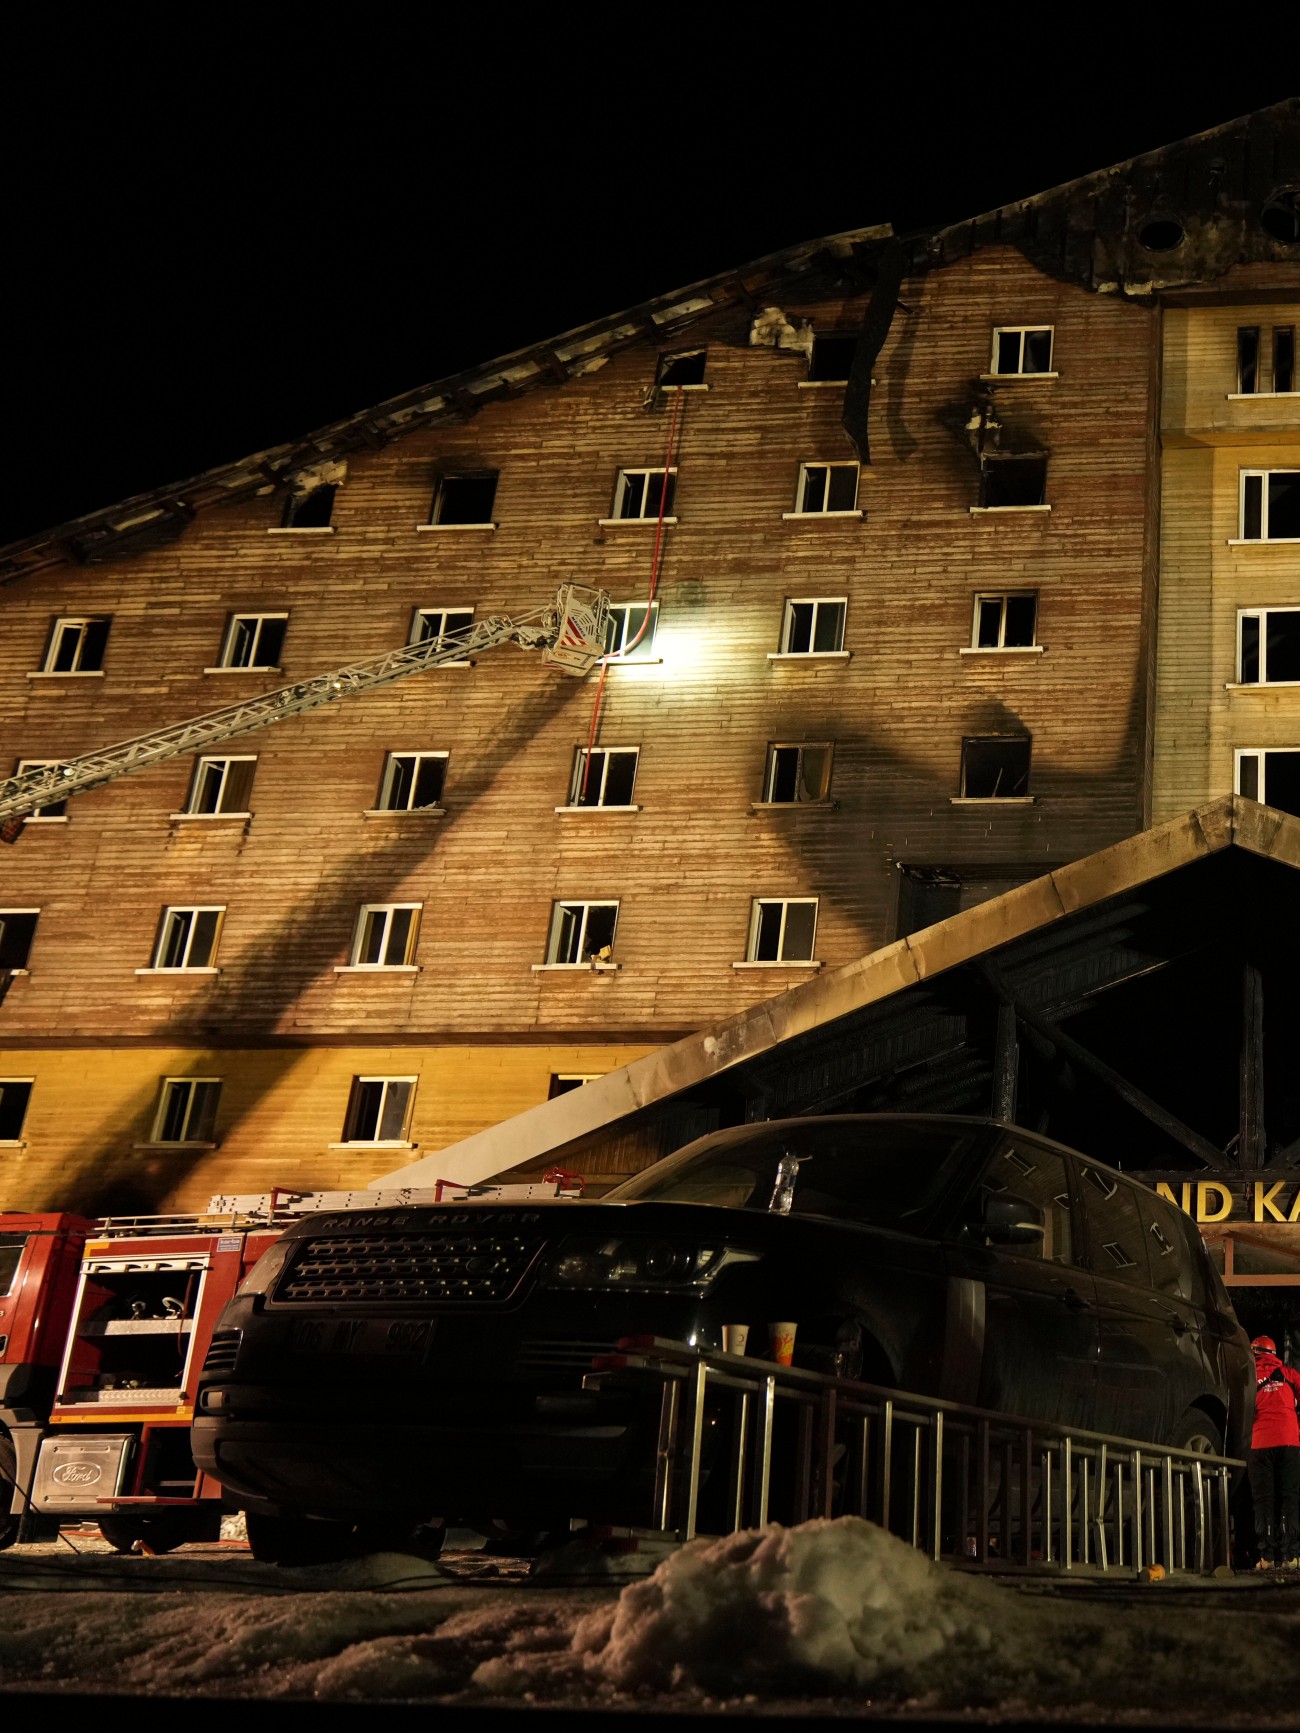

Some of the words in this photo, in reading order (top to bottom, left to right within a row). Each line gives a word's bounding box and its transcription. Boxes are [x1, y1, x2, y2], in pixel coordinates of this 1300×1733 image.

[322, 1215, 411, 1229] RANGE
[428, 1212, 541, 1225] ROVER
[61, 1465, 94, 1482] Ford
